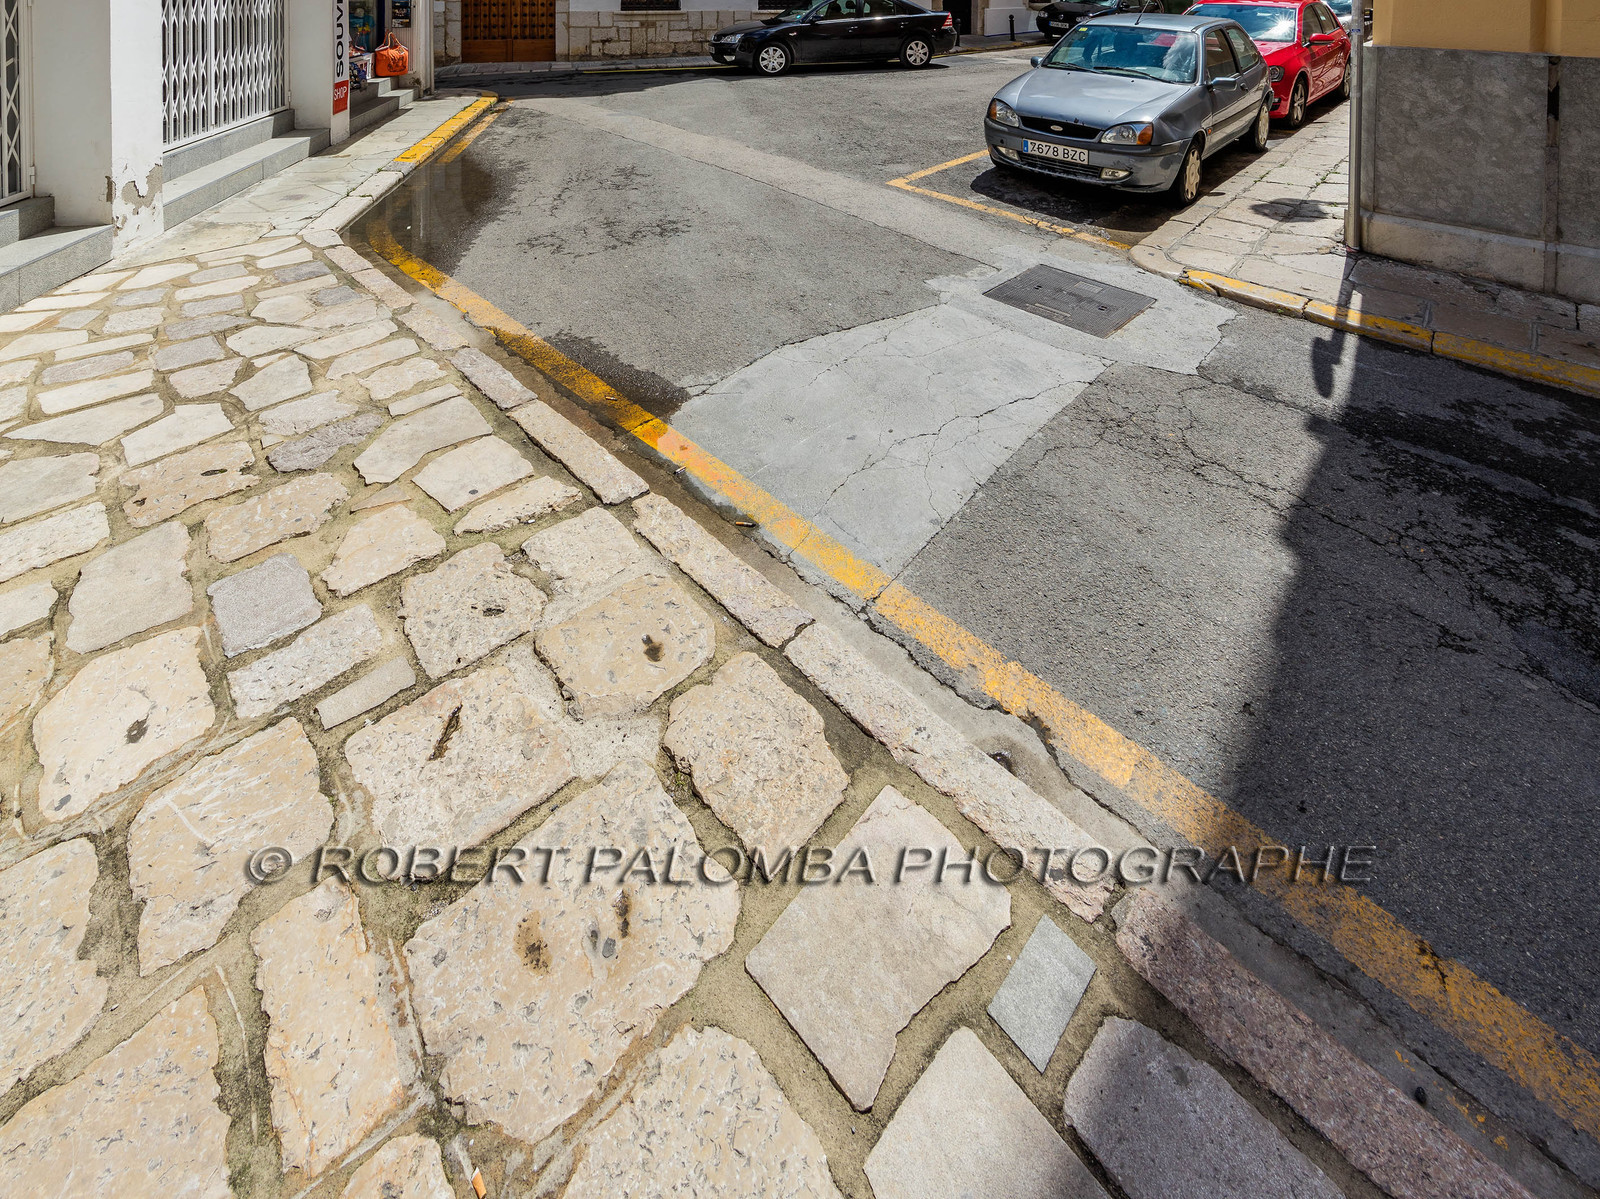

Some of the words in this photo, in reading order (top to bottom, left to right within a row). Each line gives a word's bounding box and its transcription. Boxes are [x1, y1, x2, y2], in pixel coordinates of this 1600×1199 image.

[333, 86, 348, 101] SHOP
[1030, 141, 1059, 157] 7678
[1062, 147, 1086, 162] BZC
